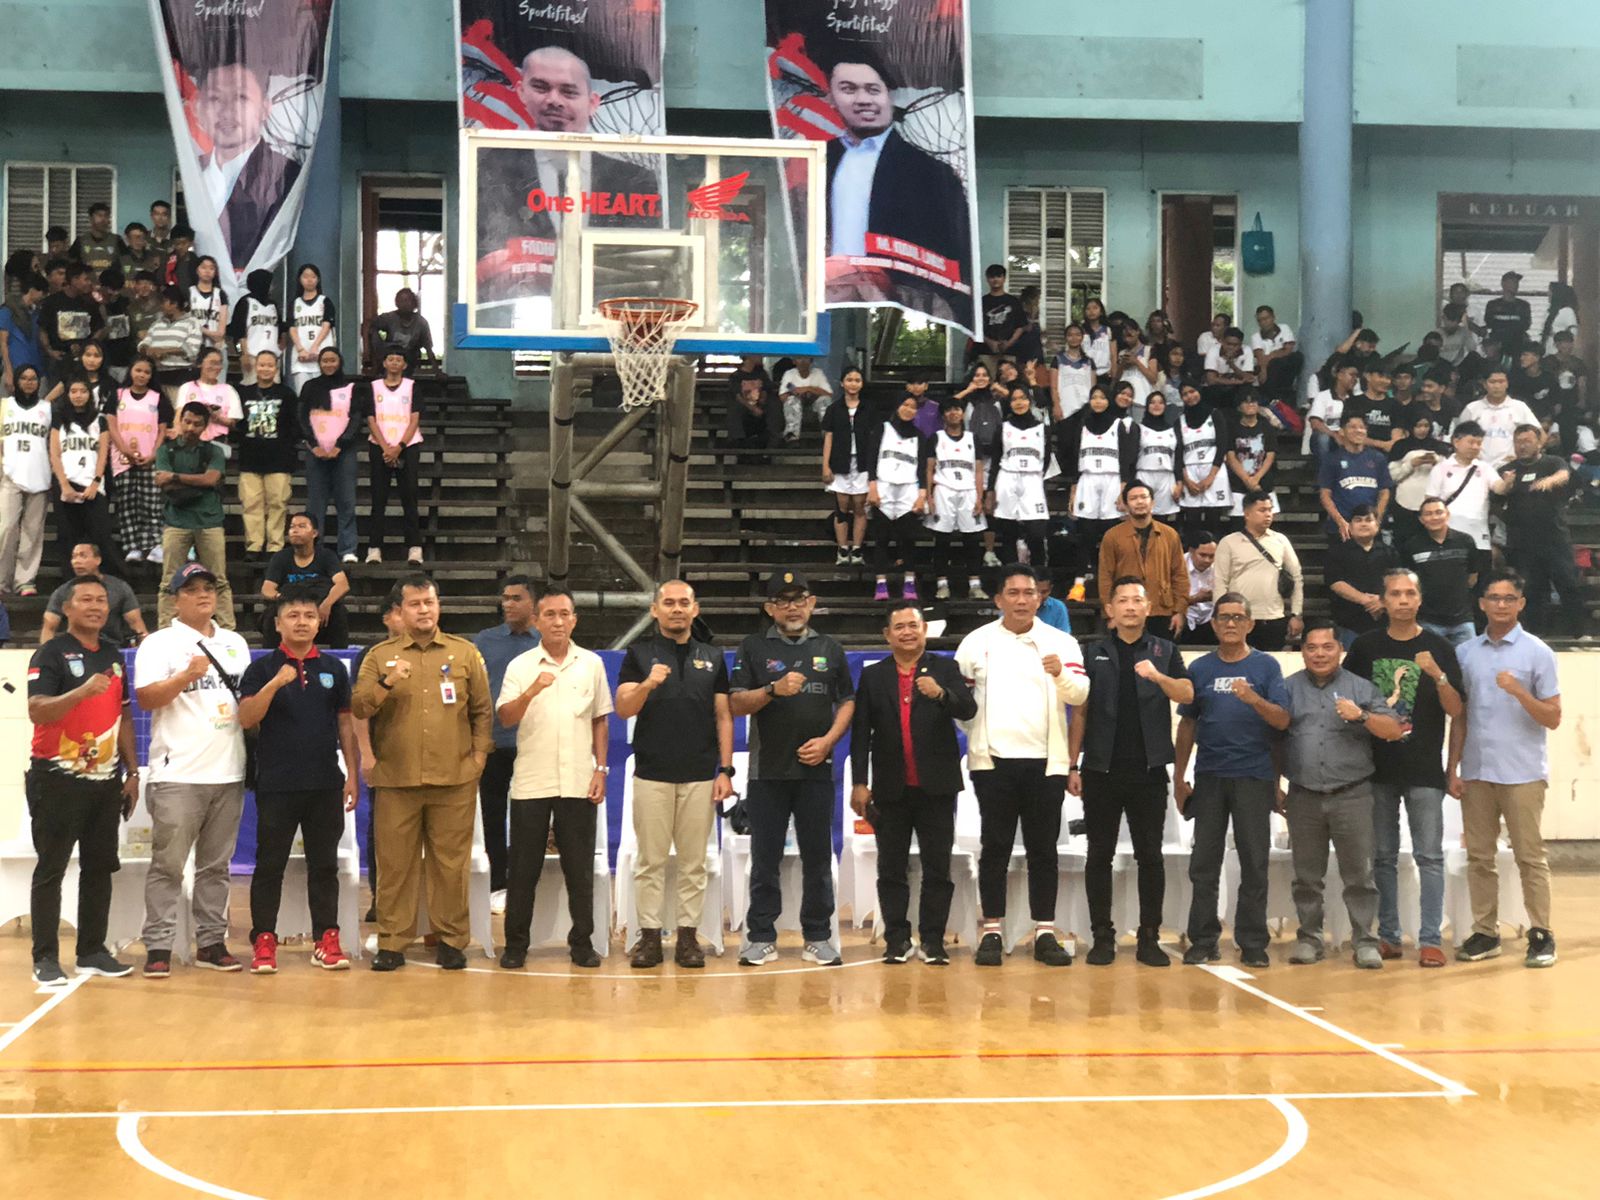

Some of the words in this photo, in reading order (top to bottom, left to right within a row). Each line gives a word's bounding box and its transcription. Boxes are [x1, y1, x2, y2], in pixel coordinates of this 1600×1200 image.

[518, 0, 589, 24] Sportifitas!
[826, 12, 893, 33] Sportifitas!
[527, 188, 574, 213] One
[687, 210, 750, 222] HONDA
[17, 439, 31, 452] 15
[78, 456, 87, 468] 4
